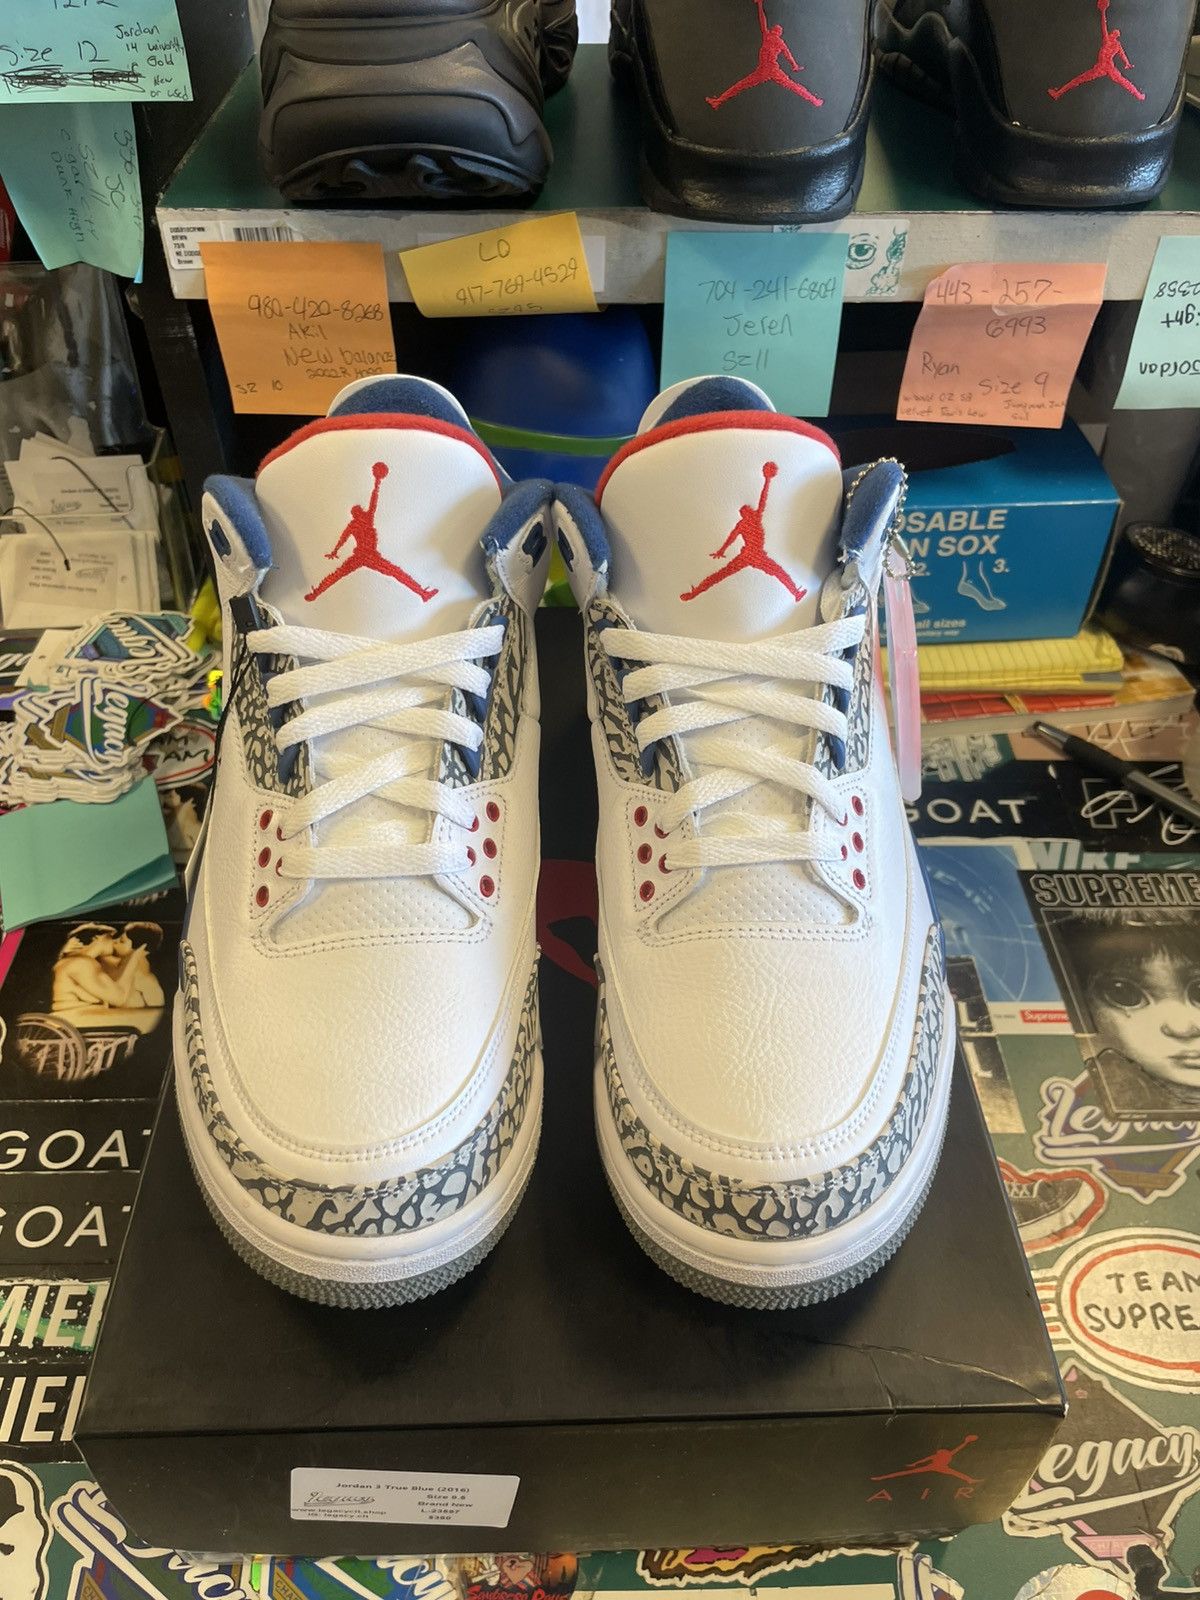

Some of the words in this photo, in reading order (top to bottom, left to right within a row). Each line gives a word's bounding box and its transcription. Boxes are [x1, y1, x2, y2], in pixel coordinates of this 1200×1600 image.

[114, 22, 160, 40] Jordan
[0, 40, 53, 66] Size
[77, 40, 110, 63] 12
[921, 351, 960, 379] Ryan
[978, 379, 1022, 396] Size
[936, 534, 1000, 557] SOX
[1030, 873, 1200, 906] SUPREME
[0, 1129, 151, 1171] GOA
[1013, 1433, 1194, 1508] egacy
